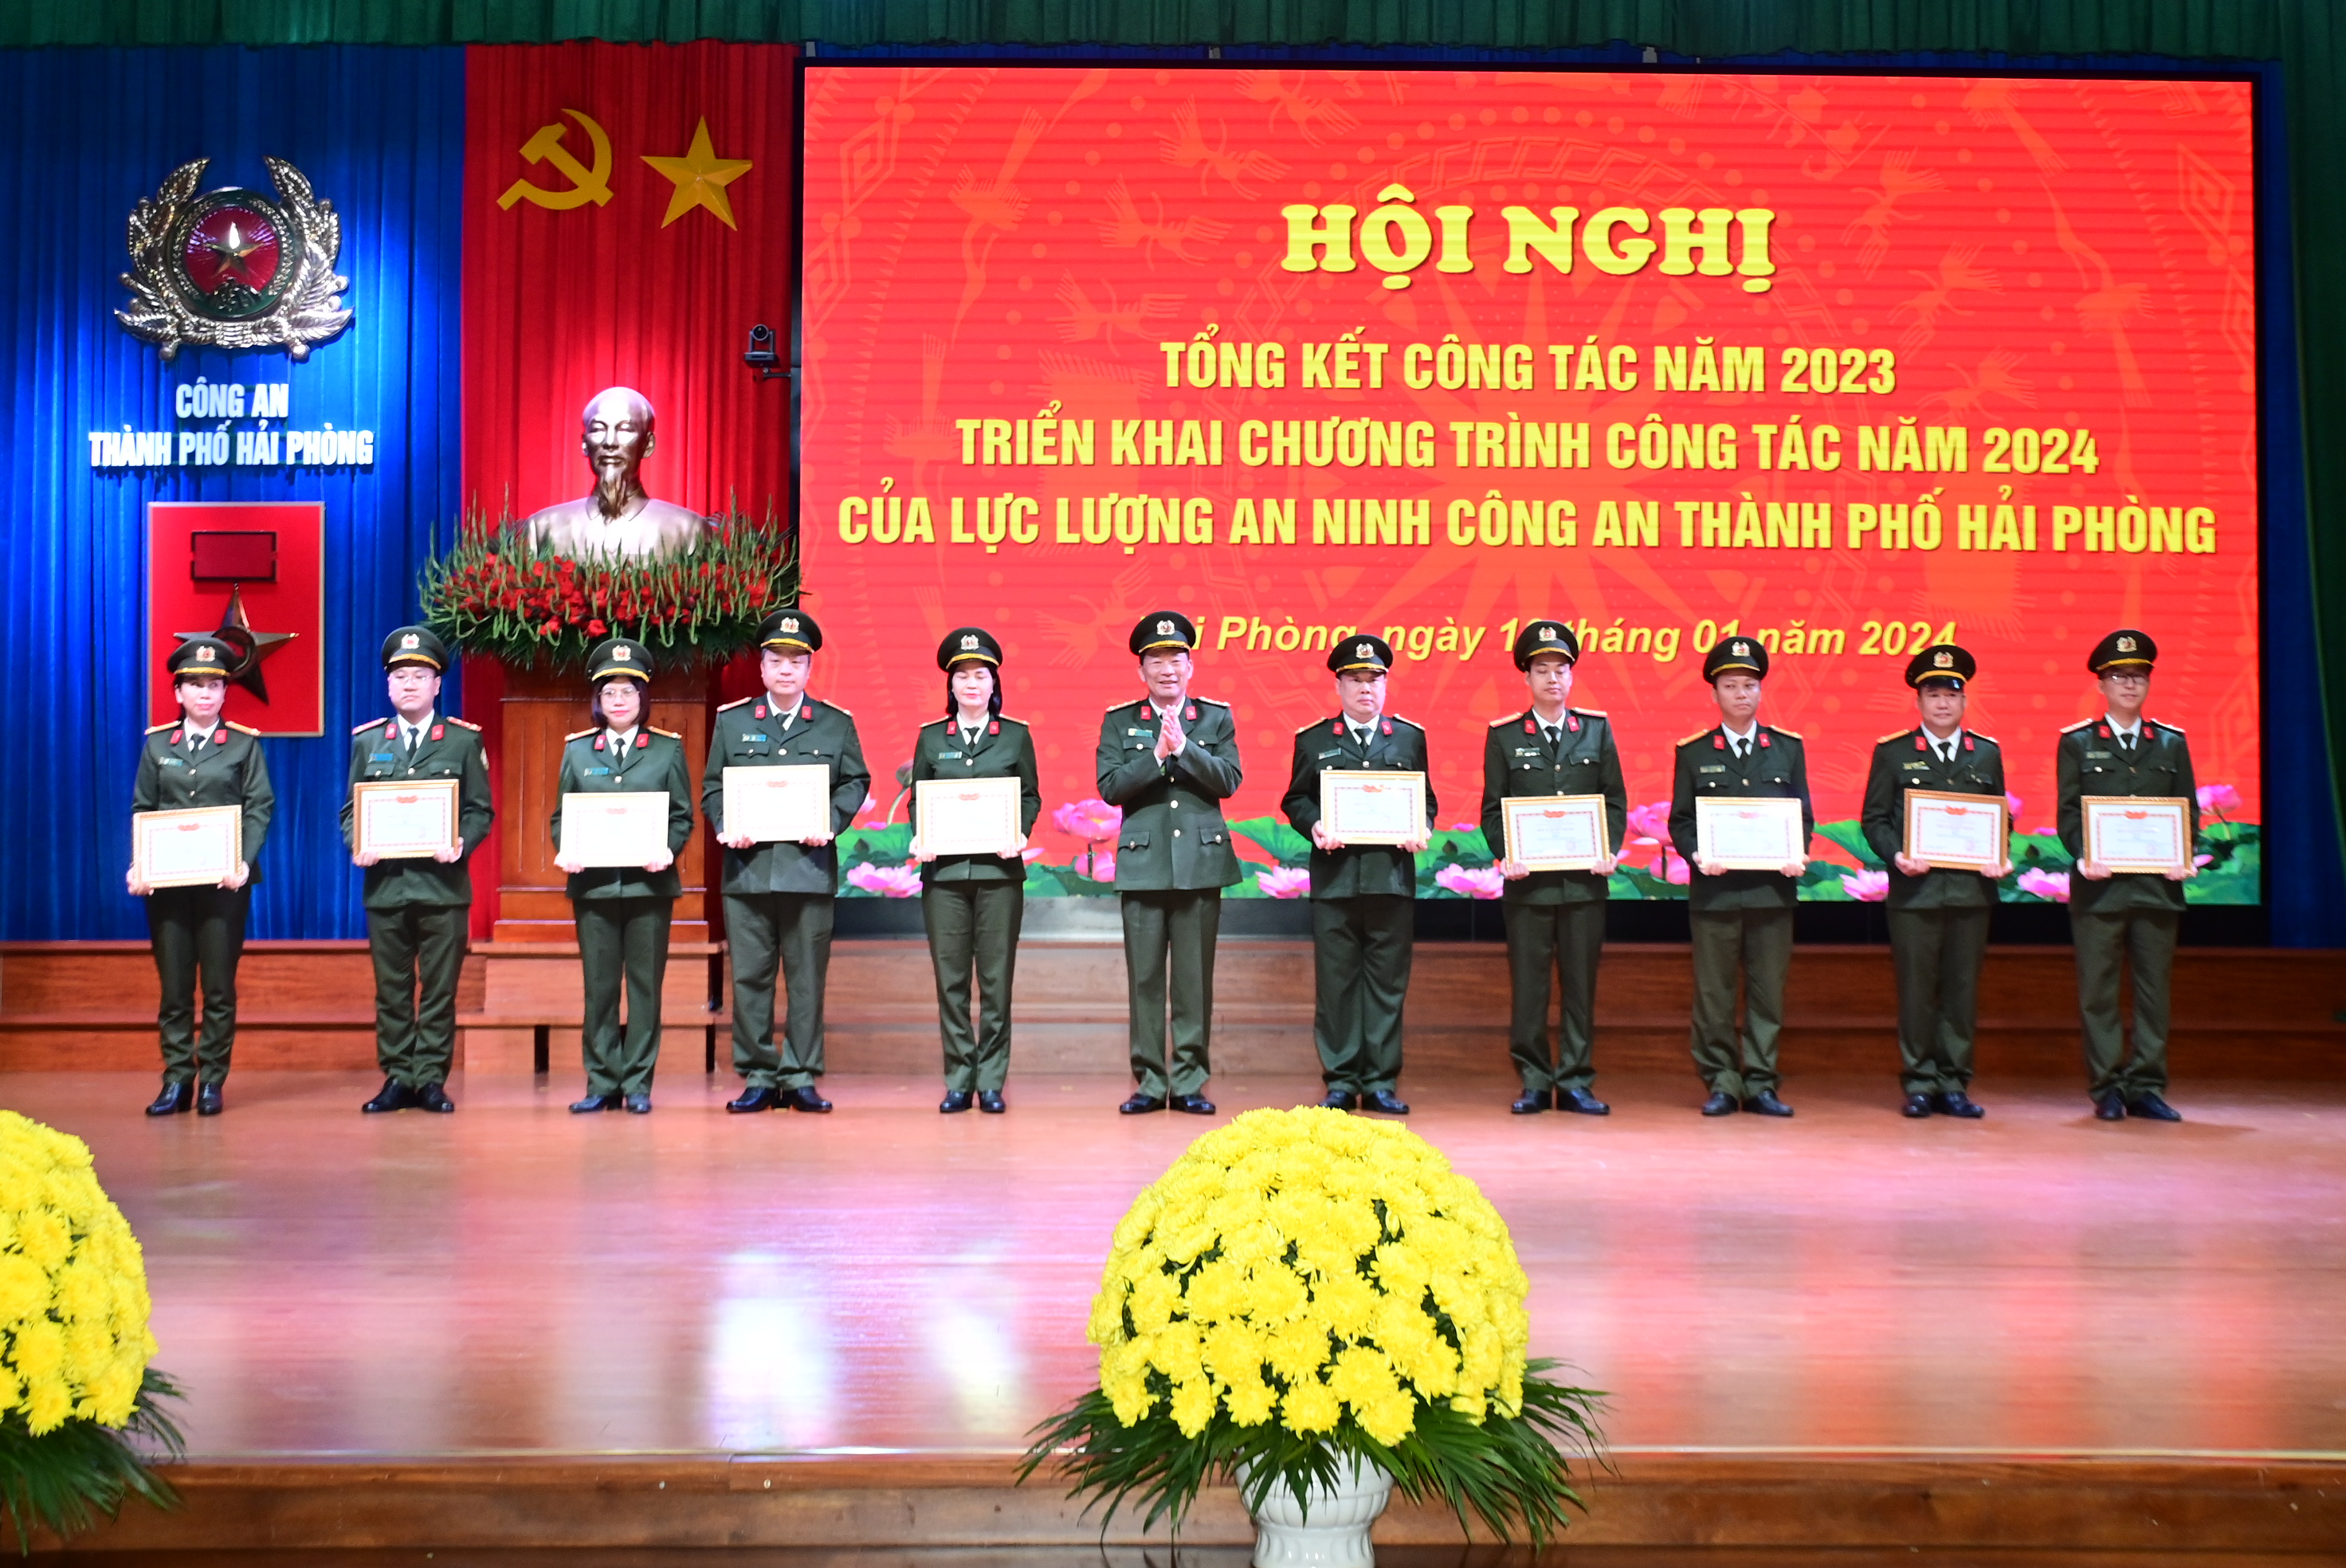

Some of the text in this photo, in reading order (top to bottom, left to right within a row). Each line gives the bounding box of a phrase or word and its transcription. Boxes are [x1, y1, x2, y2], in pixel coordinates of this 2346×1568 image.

[1281, 182, 1776, 294] HỘI NGHỊ
[1160, 323, 1896, 395] TỔNG KẾT CÔNG TÁC NĂM 2023
[175, 376, 289, 418] CÔNG AN
[88, 418, 375, 467] THÀNH PHỐ HẢI PHÒNG
[955, 399, 2100, 475] TRIỂN KHAI CHƯƠNG TRÌNH CÔNG TÁC NĂM 2024
[838, 476, 2216, 555] CỦA LỰC LƯỢNG AN NINH CÔNG AN THÀNH PHỐ HẢI PHÒNG
[1383, 616, 1487, 661] ngày
[1500, 617, 1542, 652] 1
[1693, 619, 1740, 654] 01
[1756, 619, 1846, 654] năm
[1858, 621, 1956, 656] 2024
